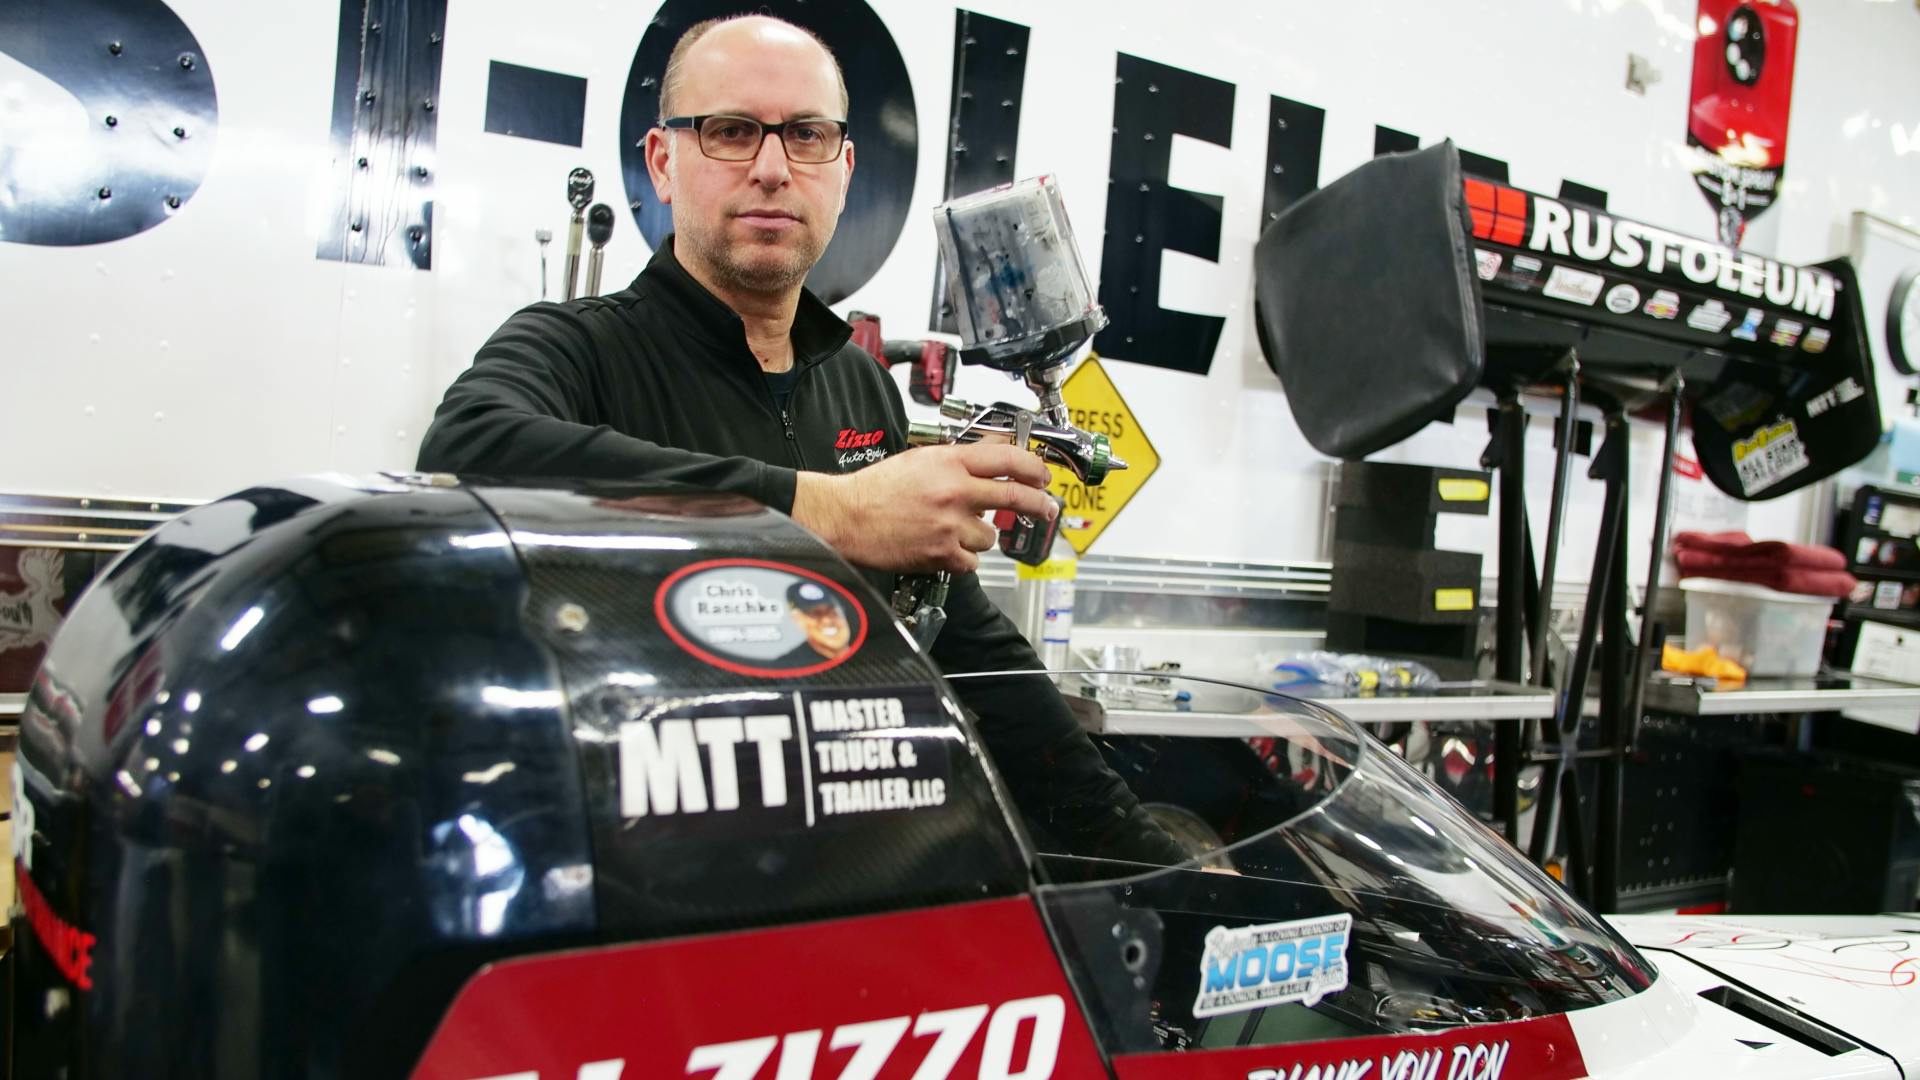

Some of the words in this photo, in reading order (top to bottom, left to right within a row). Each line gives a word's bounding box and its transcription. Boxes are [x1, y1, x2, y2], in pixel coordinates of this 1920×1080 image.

[1529, 196, 1836, 321] RUST-OLEUM
[834, 428, 885, 449] Zizzo
[1068, 408, 1124, 438] RESS
[1059, 483, 1106, 511] ZONE
[697, 602, 779, 615] Raschke
[706, 585, 754, 598] Chris
[810, 698, 906, 732] MASTER
[619, 714, 793, 818] MTT
[814, 738, 897, 773] TRUCK
[898, 740, 918, 768] &
[1205, 933, 1346, 994] MOOSE
[1381, 1048, 1443, 1080] YOU
[1447, 1039, 1510, 1080] DON
